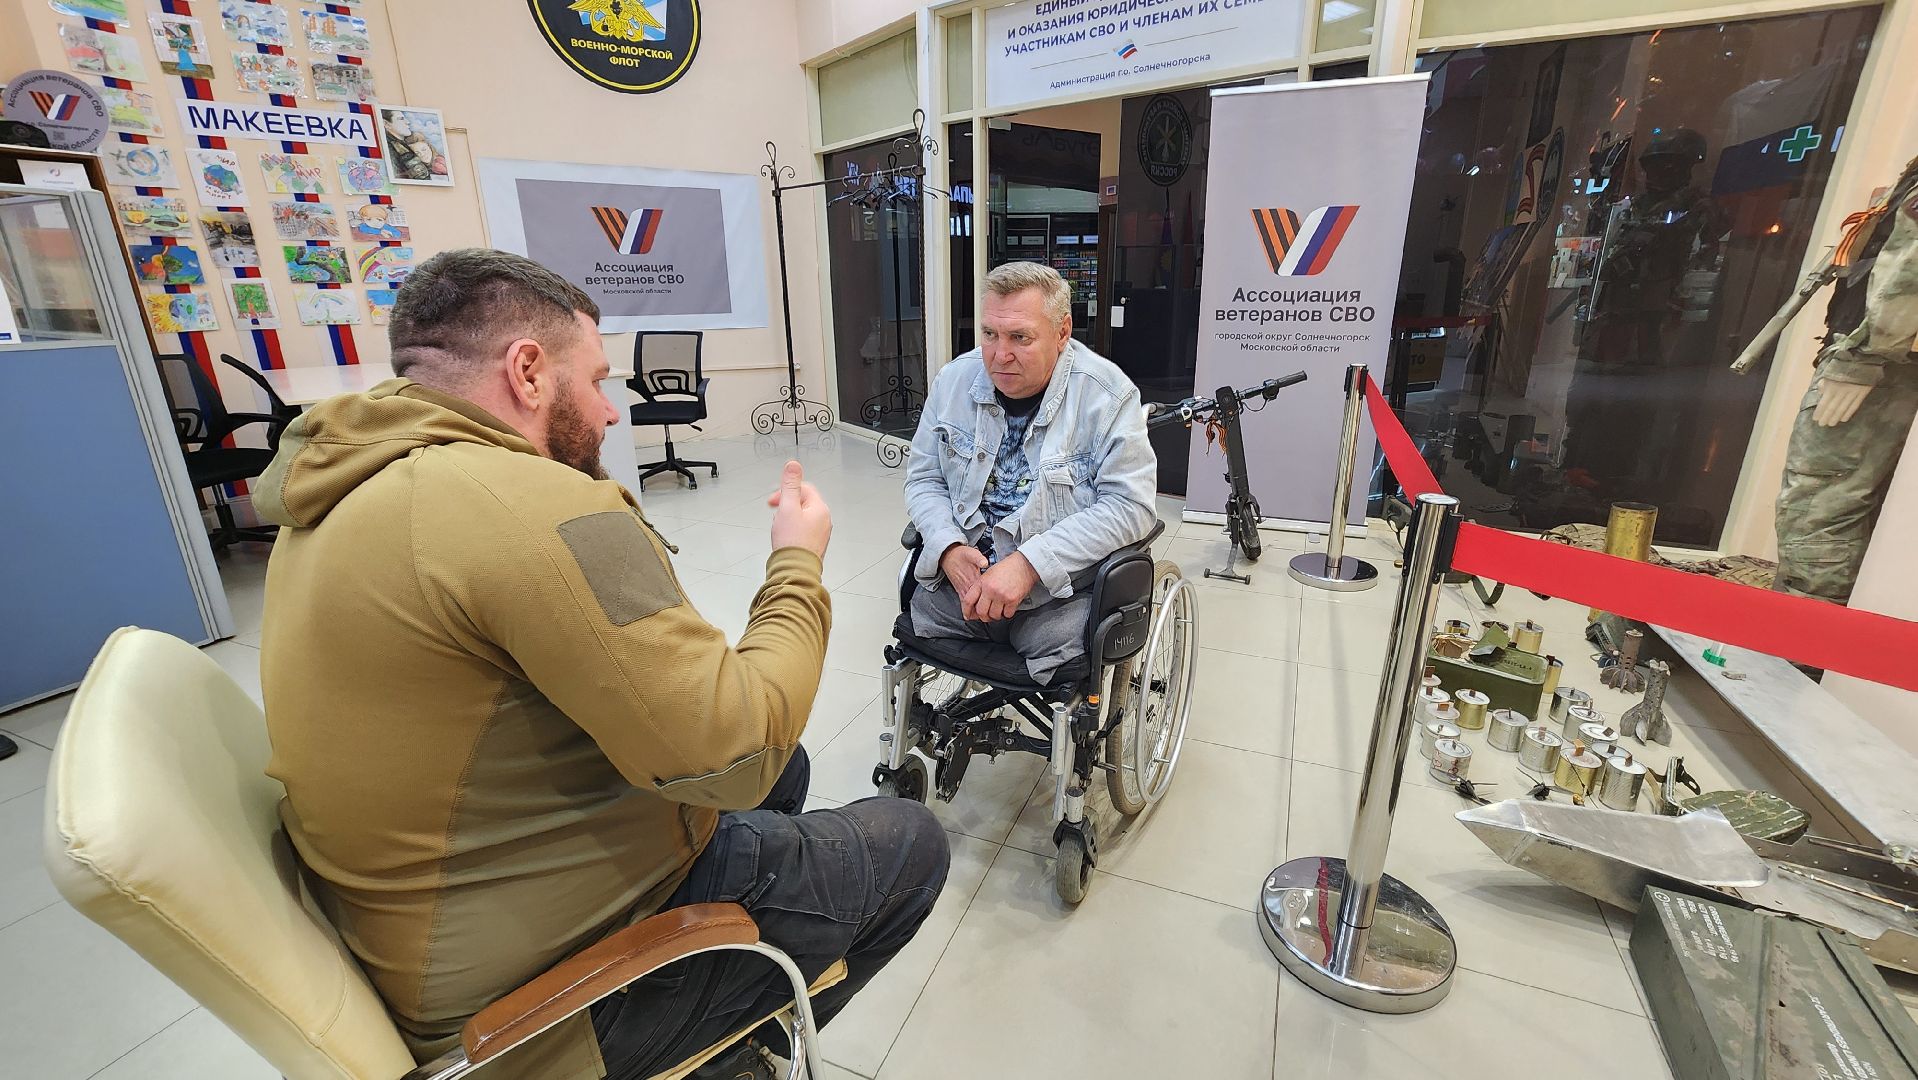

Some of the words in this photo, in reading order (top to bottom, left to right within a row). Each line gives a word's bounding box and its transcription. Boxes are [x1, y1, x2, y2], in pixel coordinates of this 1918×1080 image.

[1005, 30, 1086, 57] УЧАСТНИКАМ
[1089, 22, 1116, 38] СВО
[1119, 19, 1129, 32] И
[1133, 5, 1193, 28] ЧЛЕНАМ
[1198, 0, 1219, 15] ИХ
[1007, 28, 1016, 40] И
[1018, 12, 1084, 36] ОКАЗАНИЯ
[570, 37, 673, 60] ВОЕННО-МОРСКОЙ
[609, 55, 641, 68] ФЛОТ
[1050, 70, 1115, 89] Администрация
[1118, 69, 1131, 77] г.о.
[1133, 53, 1211, 74] Солнечногорска
[8, 74, 45, 108] Ассоциация
[46, 75, 93, 99] ветеранов
[91, 99, 104, 118] СВО
[187, 105, 368, 140] МАКЕЕВКА
[594, 262, 674, 273] Ассоциация
[585, 276, 655, 287] ветеранов
[658, 274, 685, 284] СВО
[1232, 287, 1362, 305] Ассоциация
[1215, 308, 1323, 325] ветеранов
[1329, 306, 1376, 322] СВО
[1214, 332, 1263, 341] городской
[1265, 333, 1293, 341] округ
[1295, 332, 1371, 341] Солнечногорск
[1240, 343, 1298, 352] Московской
[1300, 343, 1341, 352] области
